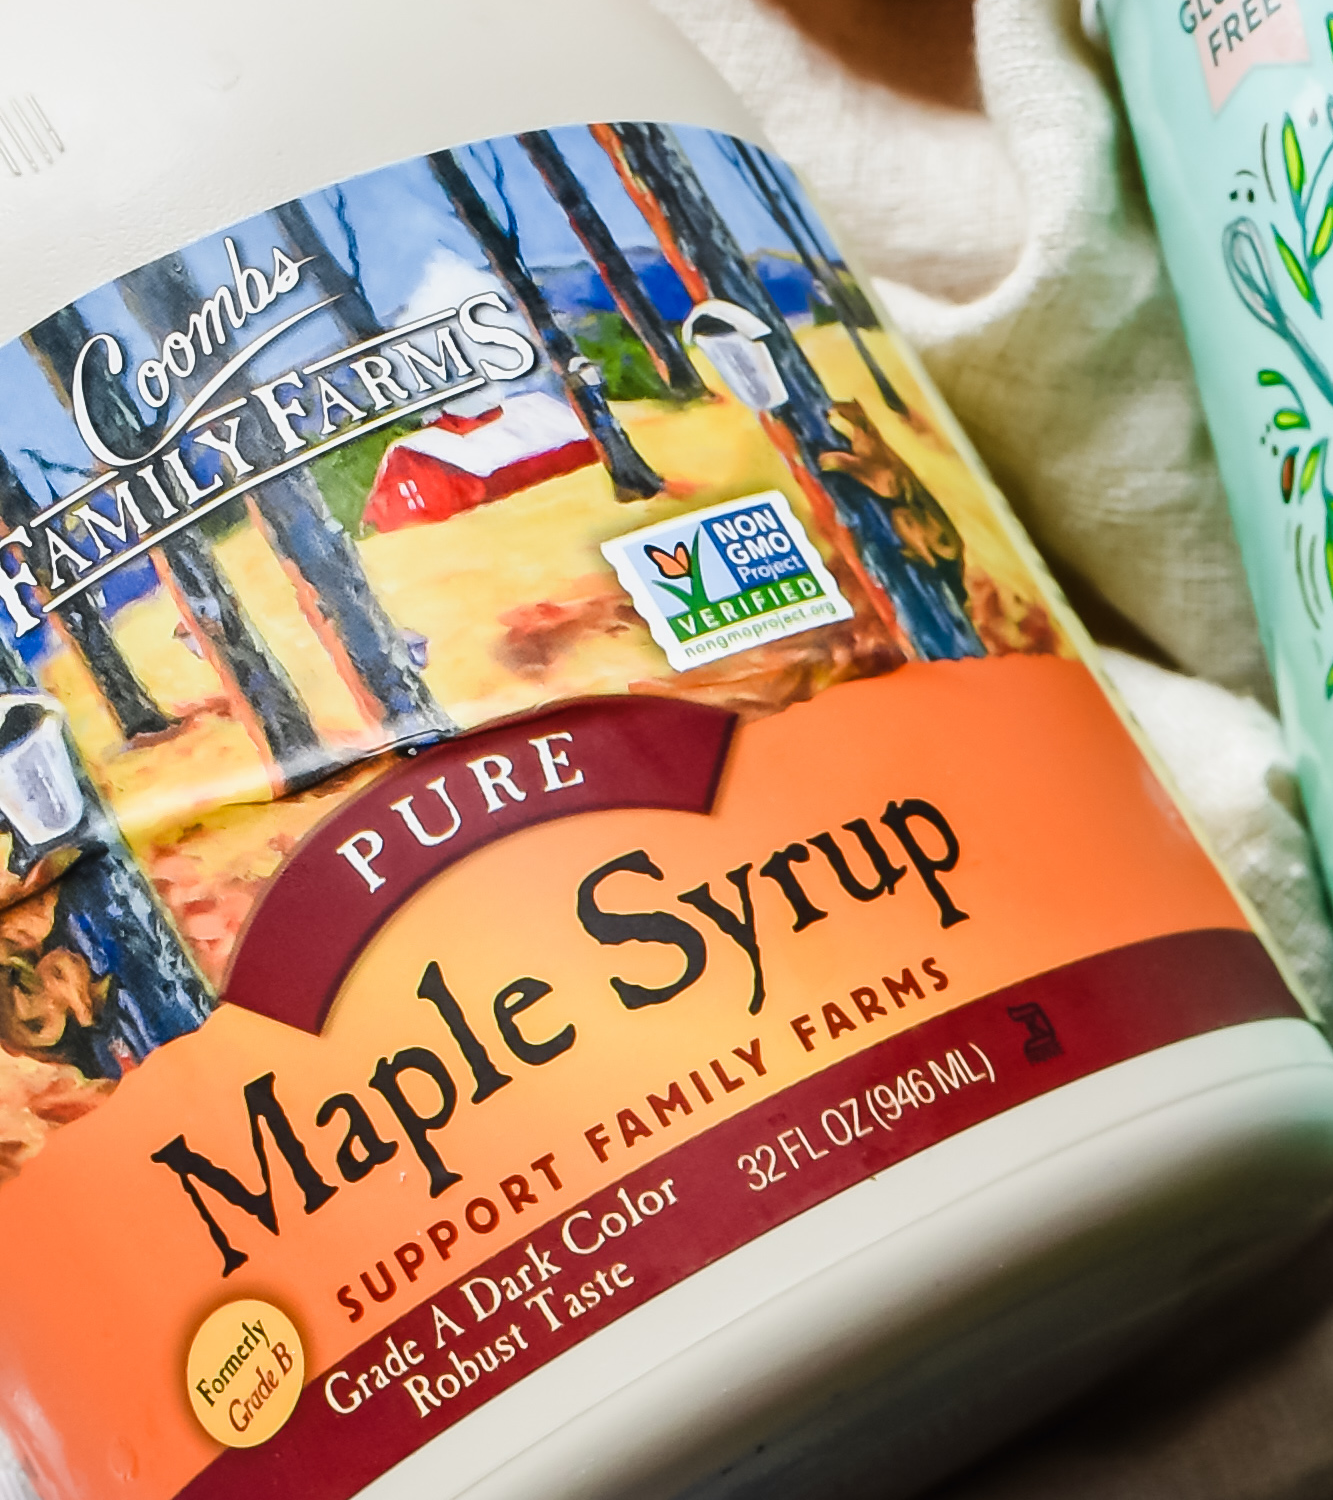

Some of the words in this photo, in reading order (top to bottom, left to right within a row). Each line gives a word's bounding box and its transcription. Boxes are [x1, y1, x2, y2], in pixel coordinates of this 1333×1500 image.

[0, 415, 256, 640] FAMILY
[250, 290, 536, 454] FARMS
[710, 506, 780, 545] NON
[725, 531, 793, 566] GMO
[736, 554, 804, 586] Project
[676, 578, 818, 637] VERIFIED
[683, 600, 838, 660] nongmoproject.org
[335, 729, 587, 896] PURE
[150, 959, 578, 1280] Maple
[575, 795, 971, 1019] Syrup
[335, 1151, 569, 1326] SUPPORT
[587, 1038, 772, 1163] FAMILY
[790, 955, 953, 1054] FARMS
[734, 1146, 783, 1193] 32
[779, 1125, 825, 1173] FL
[821, 1097, 874, 1149] OZ
[321, 1334, 428, 1419] Grade
[430, 1304, 466, 1350] A
[462, 1242, 564, 1330] Dark
[556, 1174, 680, 1259] Color
[403, 1318, 531, 1421] Robust
[523, 1258, 638, 1337] Taste
[194, 1316, 275, 1411] Formerly
[226, 1364, 289, 1435] Grade
